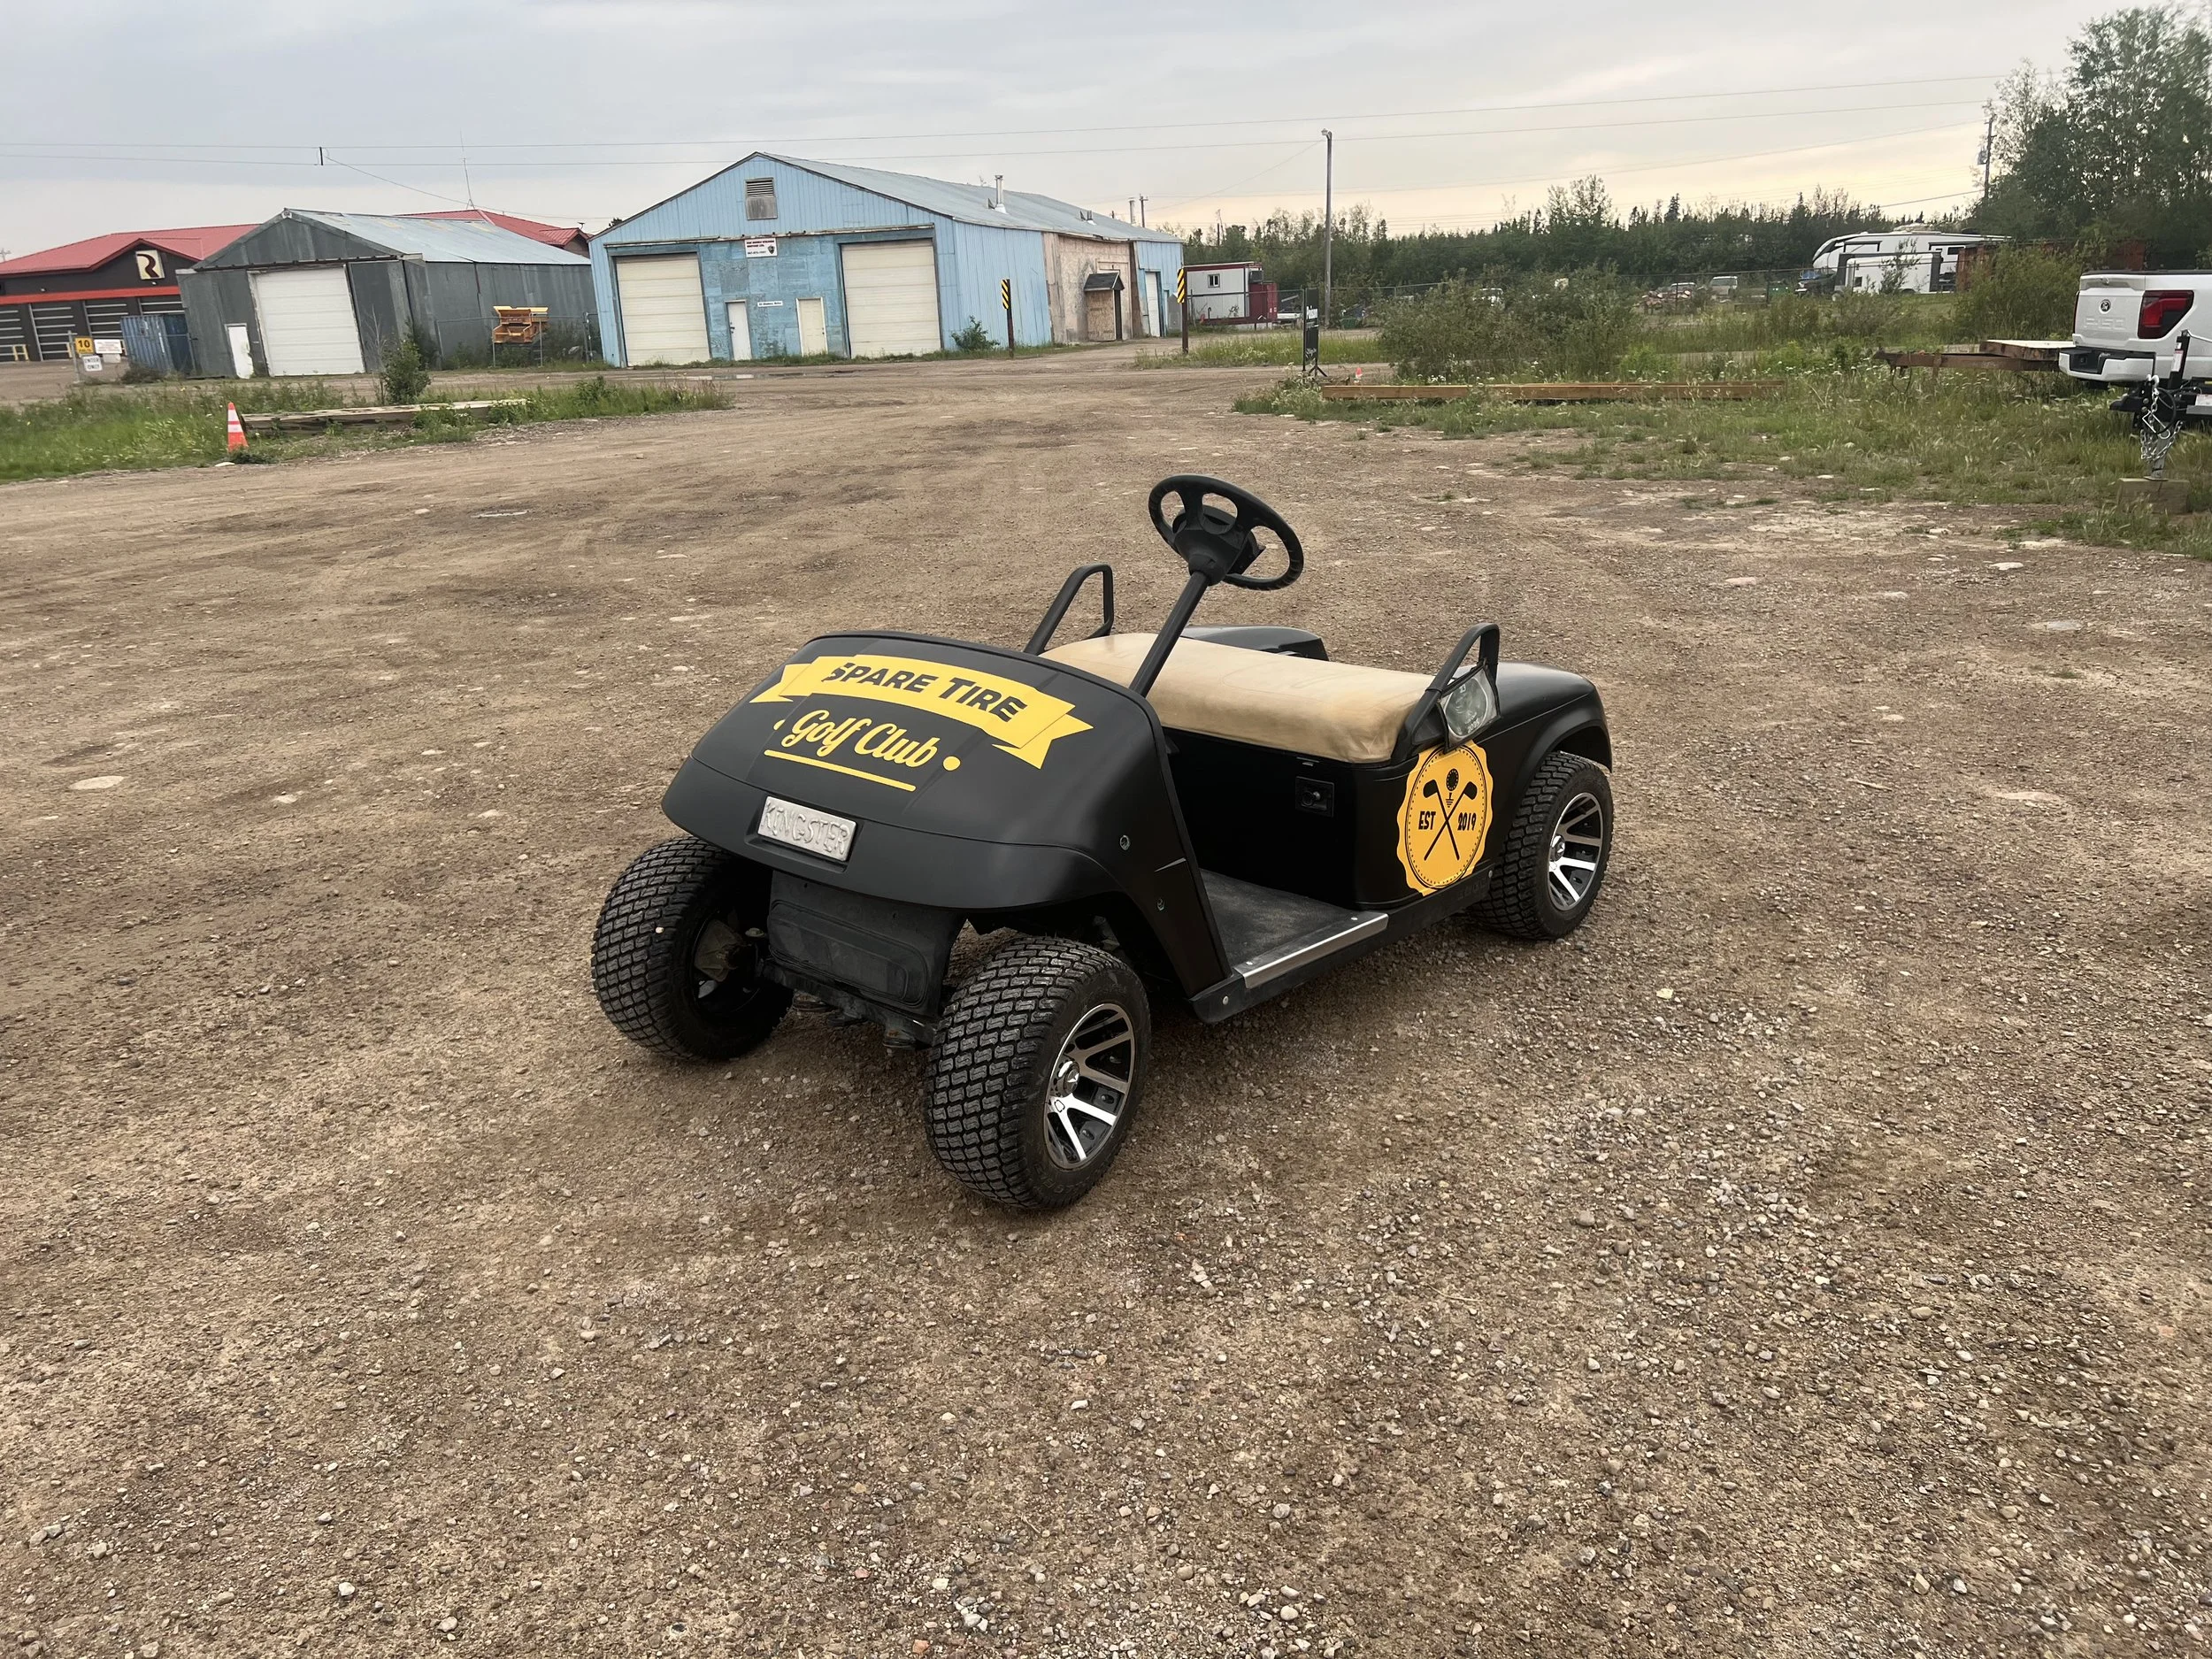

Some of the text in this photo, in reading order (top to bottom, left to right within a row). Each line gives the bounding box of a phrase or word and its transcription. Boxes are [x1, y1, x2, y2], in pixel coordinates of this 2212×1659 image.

[821, 663, 1027, 723] SPARE TIRE
[780, 710, 941, 767] Golf Club
[762, 800, 850, 856] KINGSTER
[1418, 811, 1476, 831] EST 2019
